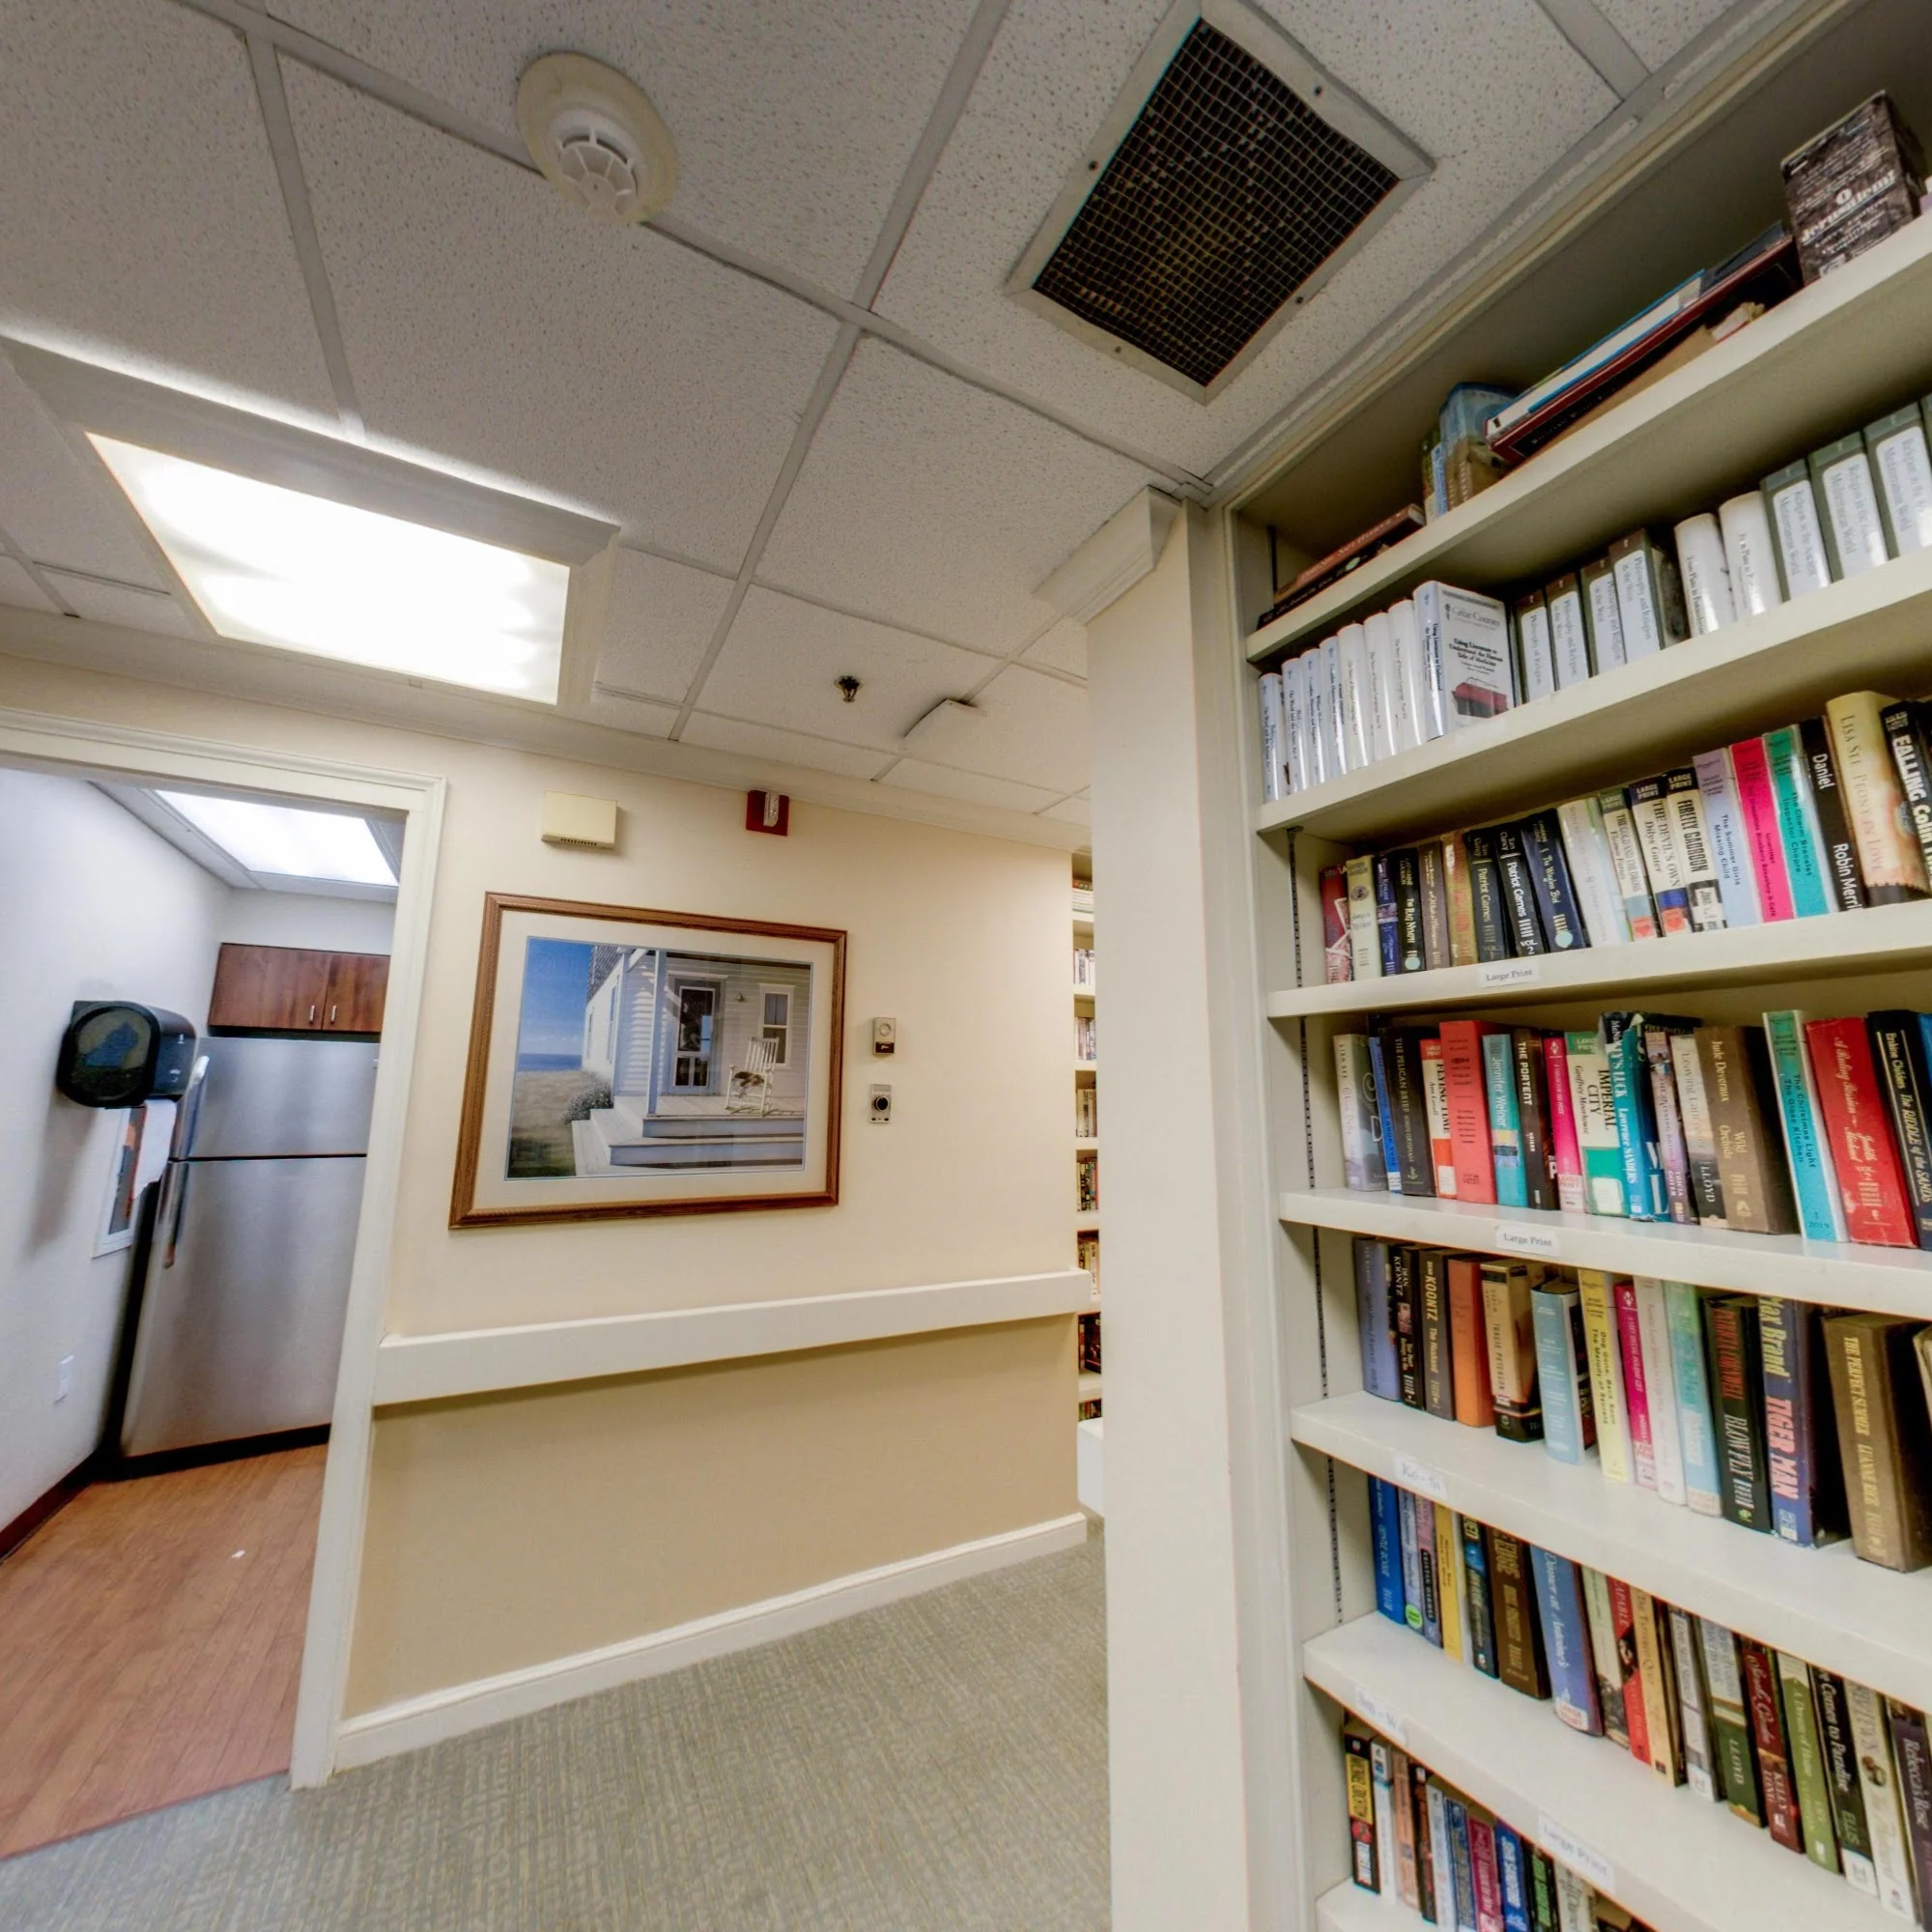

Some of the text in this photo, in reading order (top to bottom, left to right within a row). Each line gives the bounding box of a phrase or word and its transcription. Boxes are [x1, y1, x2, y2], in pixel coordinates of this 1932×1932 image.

[1841, 529, 1857, 554] World
[1641, 611, 1653, 640] Religion
[1839, 715, 1857, 742] LISA
[1669, 773, 1692, 782] LARGE
[1677, 799, 1698, 829] FIREFLY
[1721, 814, 1730, 829] The
[1812, 753, 1835, 790] Daniel
[1833, 843, 1853, 877] Robin
[1913, 804, 1932, 843] Colin
[1499, 831, 1509, 851] Clancy
[1644, 821, 1658, 844] Dilys
[1652, 802, 1681, 887] THE DEVIL'S OWN
[1783, 798, 1803, 873] Inspector Chopra
[1791, 792, 1812, 877] The Charm Bracelet
[1542, 855, 1553, 867] The
[1683, 831, 1710, 873] GADROON
[1714, 824, 1731, 879] Missing Child
[1507, 862, 1522, 889] Patriot
[1478, 867, 1493, 923] Patriot Games
[1513, 889, 1526, 918] Games
[1405, 908, 1416, 922] RAG
[1406, 922, 1416, 943] NYMPH
[1526, 947, 1535, 955] 2
[1511, 969, 1533, 978] Print
[1338, 1043, 1348, 1063] LISA
[1395, 1037, 1404, 1054] THE
[1833, 1037, 1845, 1047] A
[1396, 1055, 1406, 1090] PELICAN
[1574, 1065, 1585, 1095] Geoffrey
[1710, 1040, 1730, 1103] Jude Deveraux
[1835, 1047, 1851, 1080] Ruling
[1435, 1063, 1451, 1134] FLYING TIME
[1492, 1057, 1509, 1128] Jennifer Weiner
[1588, 1084, 1602, 1116] CITY
[1613, 1070, 1627, 1097] LUCK
[1401, 1090, 1410, 1113] BRIEF
[1598, 1070, 1617, 1131] IMPERIAL
[1617, 1107, 1629, 1148] Lawrence
[1679, 1053, 1696, 1094] Leaving
[1699, 1165, 1716, 1203] LLOYD
[1783, 1079, 1804, 1163] The Glass Kitchen
[1793, 1072, 1816, 1169] The Christmas Light
[1885, 1033, 1932, 1203] Erskine Childers The RIDDLE of the SANDS
[1406, 1130, 1414, 1163] GRISHAM
[1719, 1124, 1733, 1159] Orchids
[1733, 1130, 1747, 1153] Wild
[1622, 1148, 1638, 1184] SANDERS
[1667, 1171, 1677, 1197] GOYER
[1675, 1171, 1685, 1196] TRICIA
[1503, 1233, 1552, 1246] Large Print
[1393, 1256, 1403, 1296] KOONTZ
[1424, 1275, 1437, 1321] KOONTZ
[1492, 1323, 1501, 1350] TRACIE
[1591, 1328, 1600, 1345] The
[1599, 1331, 1608, 1349] Dog
[1762, 1325, 1791, 1379] Brand
[1430, 1341, 1438, 1373] Husband
[1493, 1350, 1505, 1391] PETERSON
[1594, 1347, 1604, 1378] Melody
[1723, 1414, 1752, 1451] BLOW
[1765, 1395, 1796, 1453] TIGER
[1843, 1337, 1880, 1507] THE PERFECT SUMMER LUANNE RICE
[1729, 1450, 1754, 1482] FLY
[1770, 1453, 1800, 1500] MAN
[1546, 1555, 1561, 1592] Dinner
[1549, 1594, 1561, 1611] at
[1675, 1619, 1687, 1645] Love
[1730, 1739, 1745, 1785] LLOYD
[1822, 1683, 1861, 1844] Comes to Paradise ELLIS
[1774, 1774, 1786, 1811] KELLY
[1903, 1739, 1930, 1830] Rebecca's Rose
